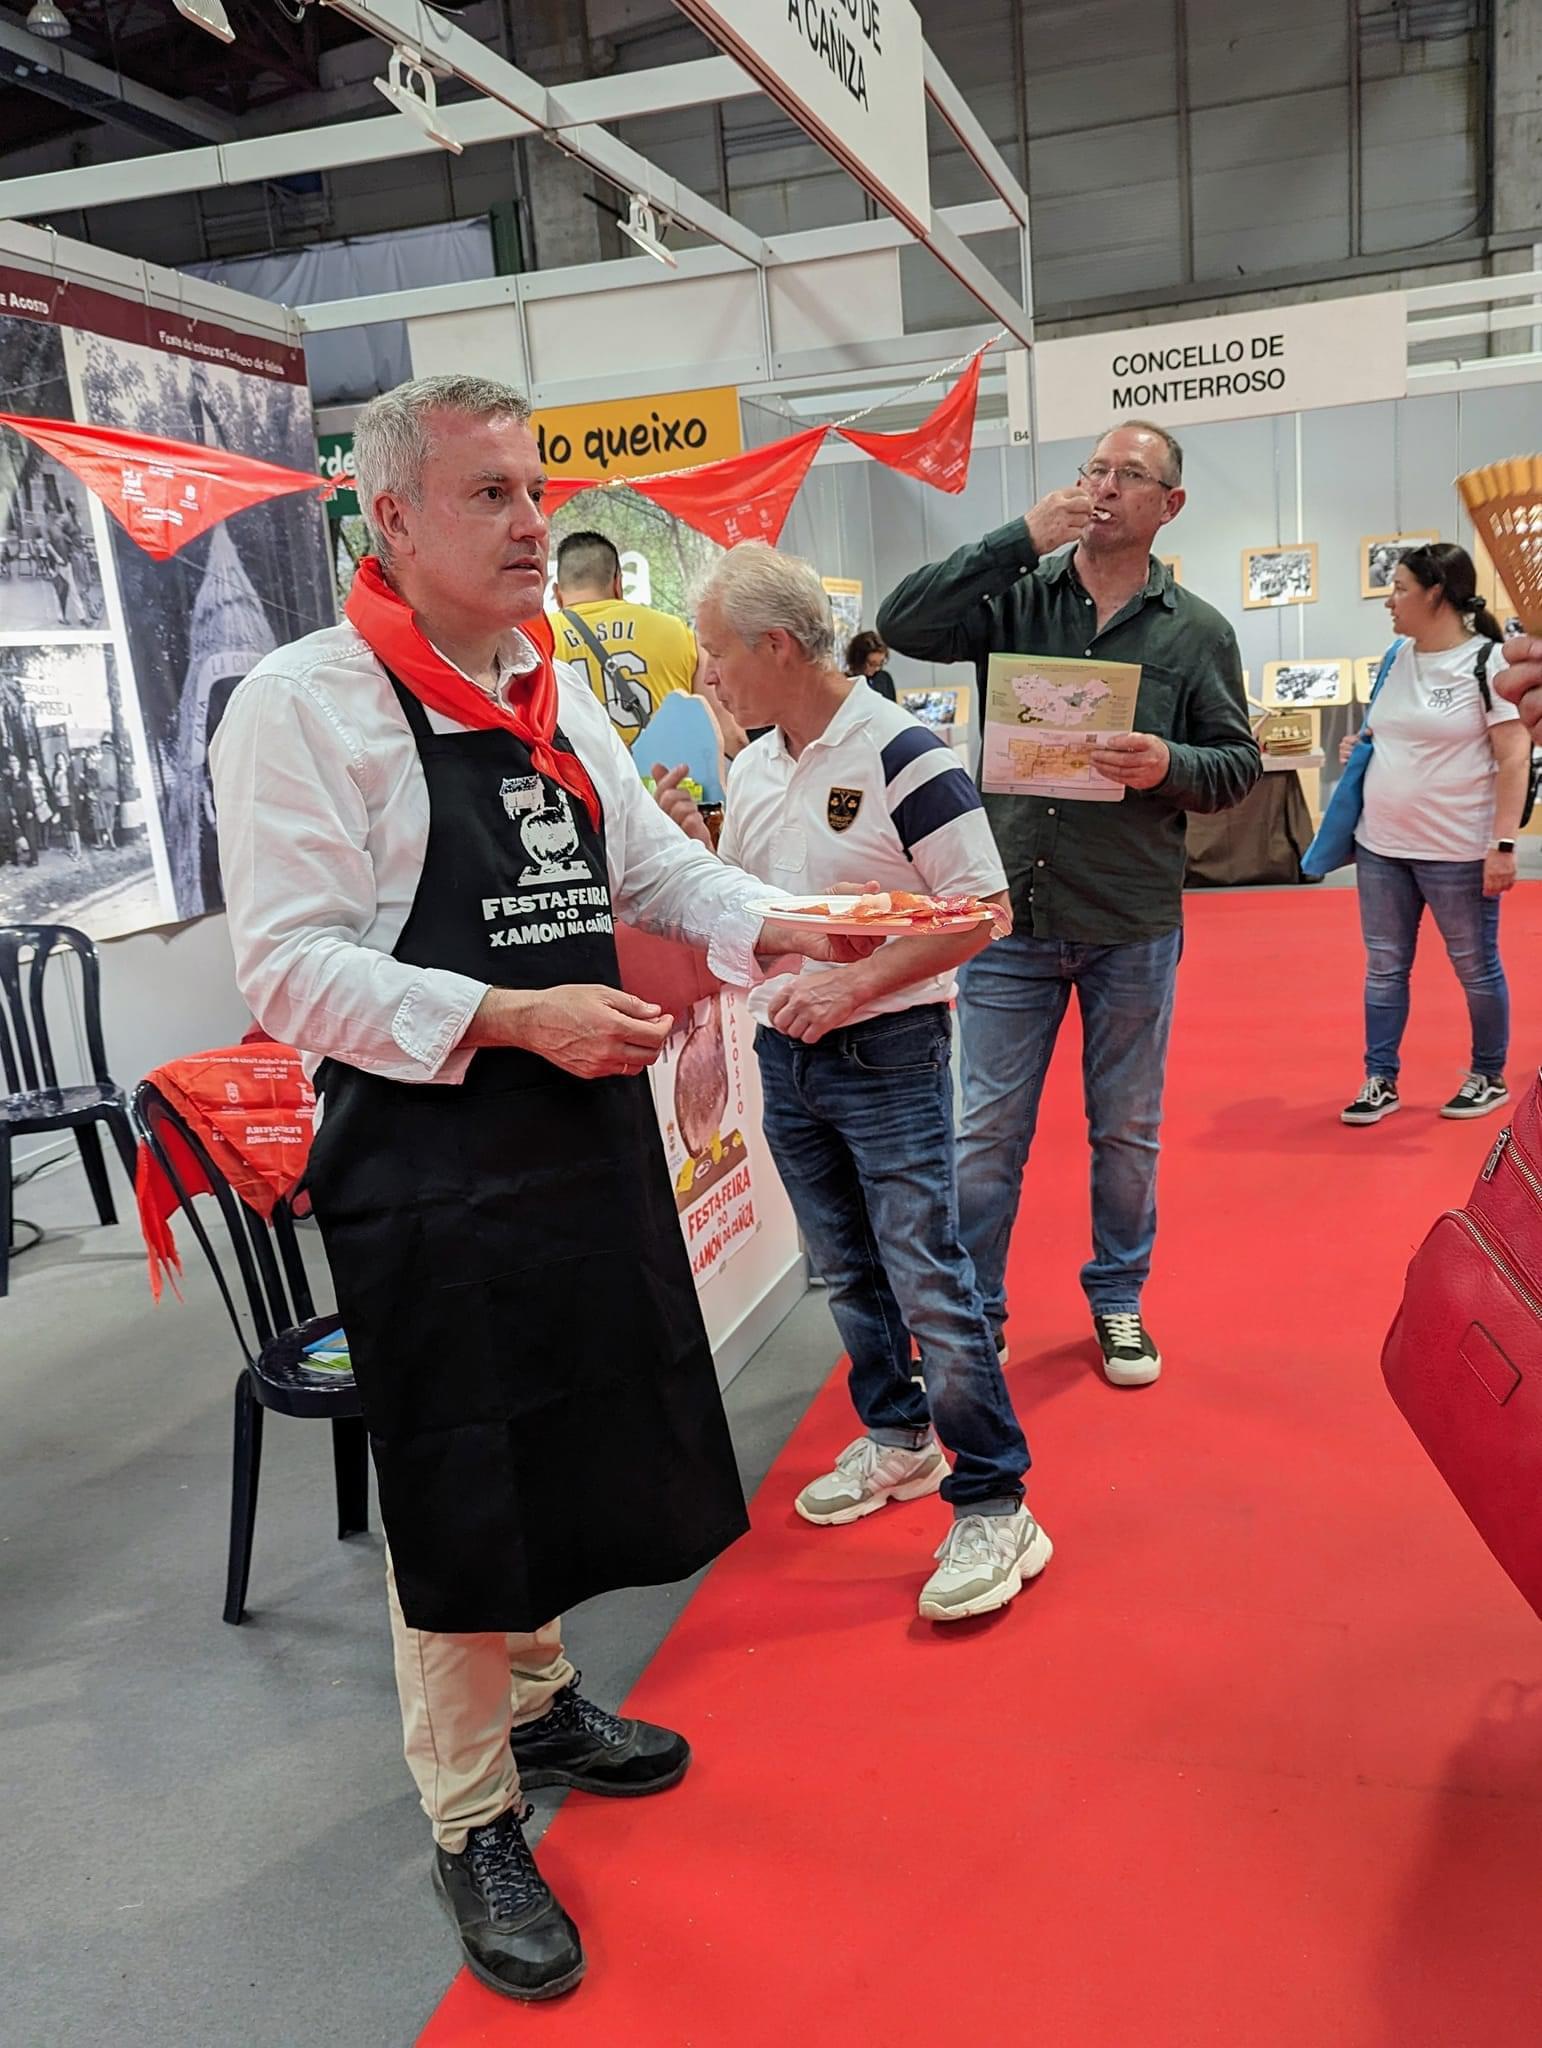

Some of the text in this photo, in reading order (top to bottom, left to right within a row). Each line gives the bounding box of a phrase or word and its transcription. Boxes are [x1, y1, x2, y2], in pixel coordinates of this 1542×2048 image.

[805, 0, 869, 113] CAÑIZA
[1112, 335, 1284, 377] CONCELLO DE
[1112, 368, 1285, 410] MONTERROSO
[584, 411, 707, 469] queixo
[563, 621, 635, 648] GSOL
[481, 885, 610, 921] FESTA-FEIRA
[556, 907, 580, 920] DO
[488, 922, 566, 947] XAMON
[687, 1165, 751, 1242] FESTA-FEIRA
